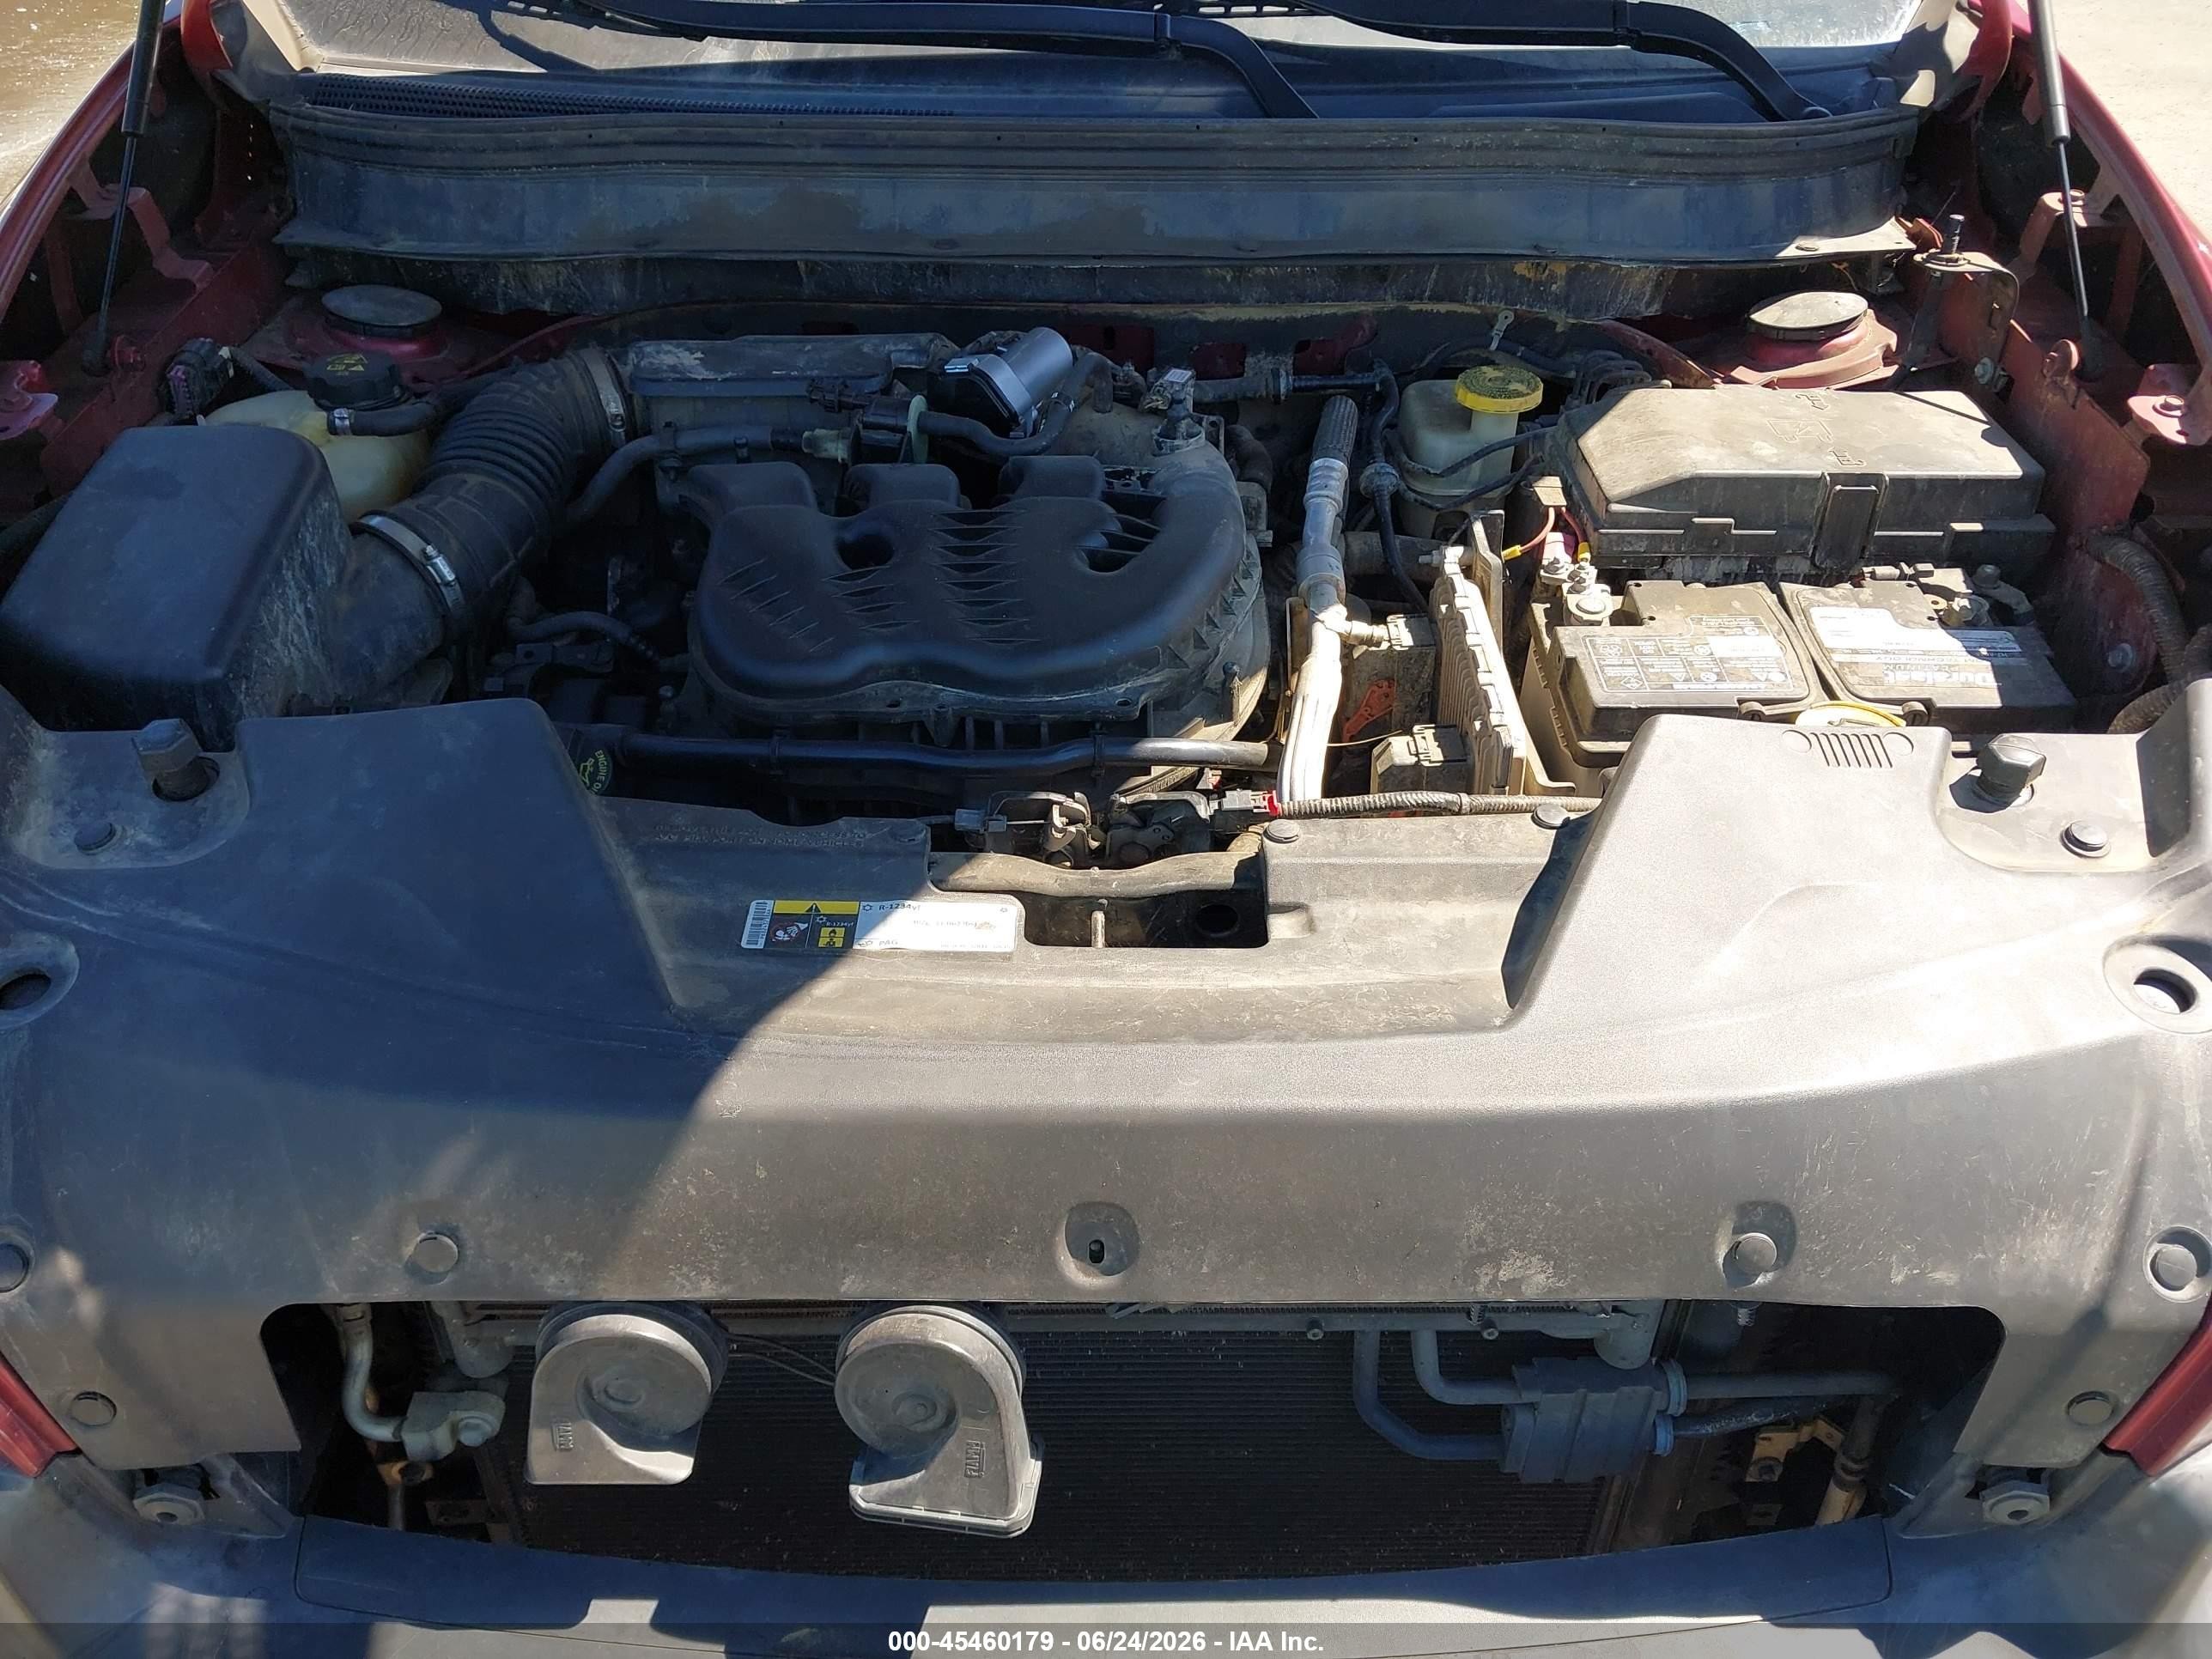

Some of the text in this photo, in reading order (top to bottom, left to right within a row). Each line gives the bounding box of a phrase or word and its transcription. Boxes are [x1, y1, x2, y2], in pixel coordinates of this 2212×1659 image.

[1882, 664, 1960, 672] PLATINUM
[1882, 670, 1999, 687] Duralast
[594, 750, 608, 783] ENGINE
[966, 1440, 981, 1476] FIAMM
